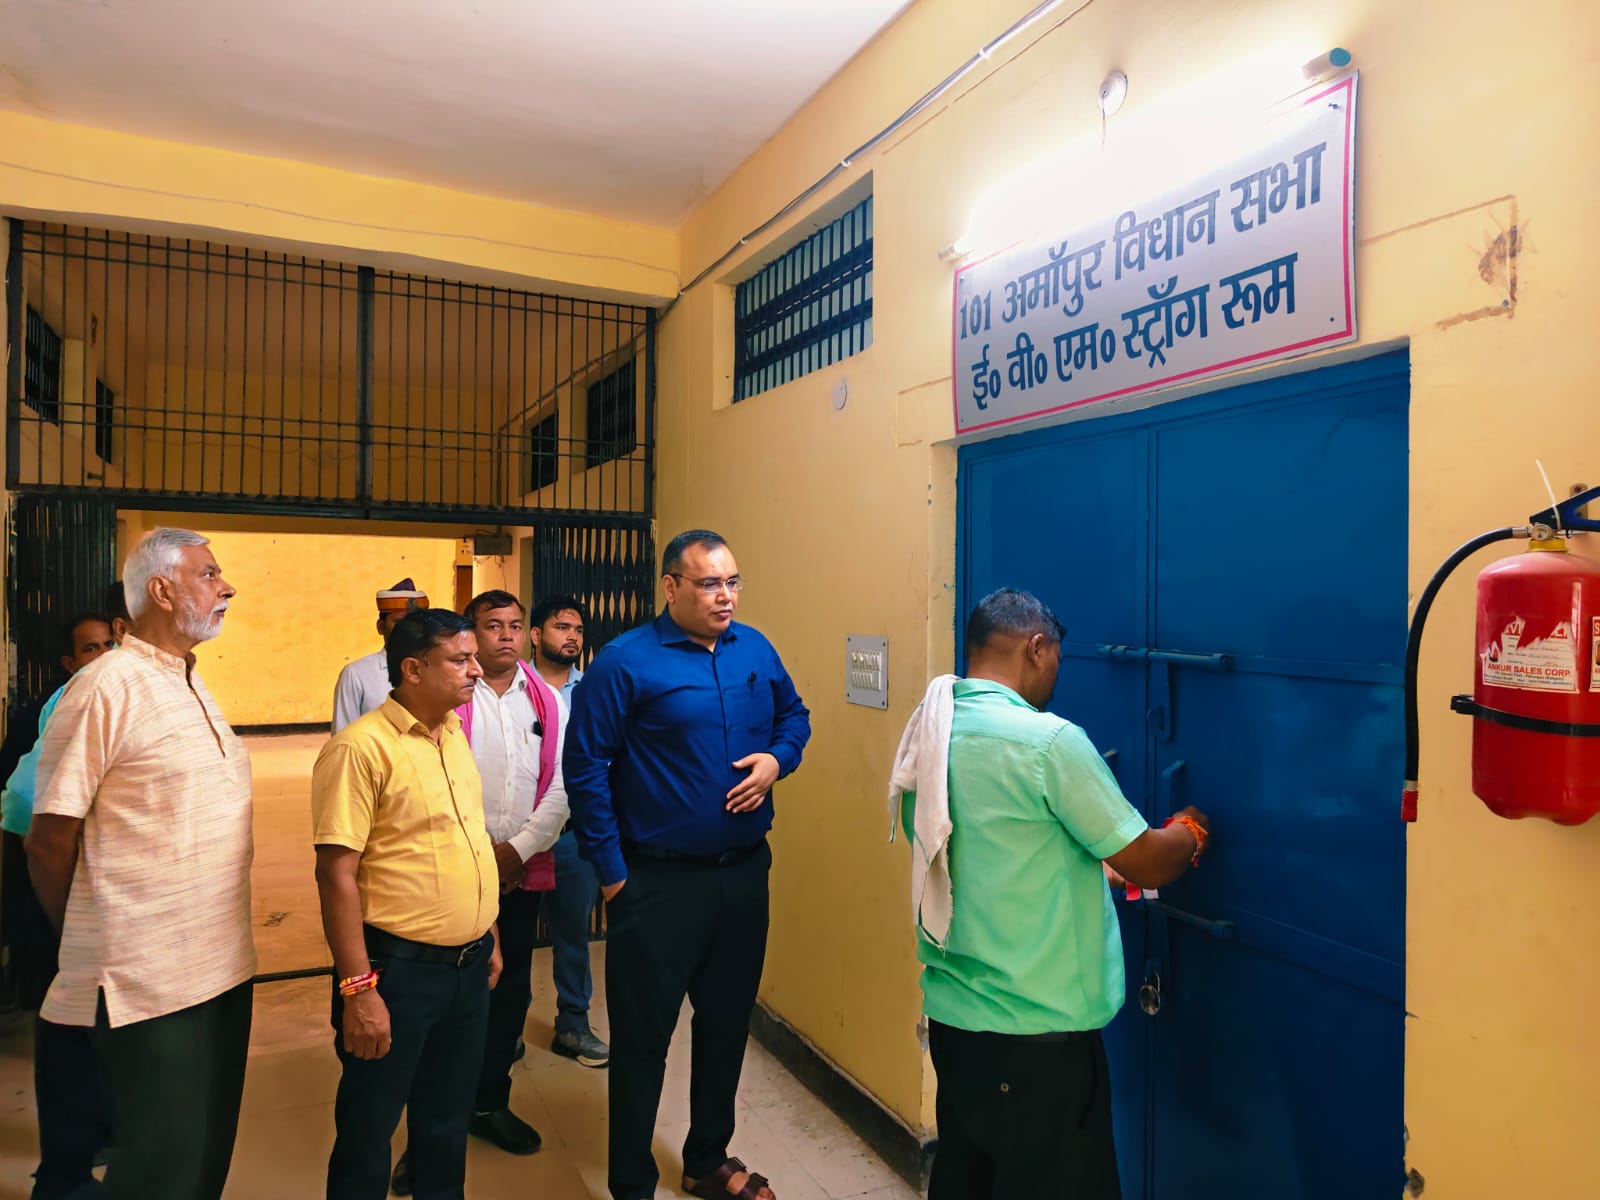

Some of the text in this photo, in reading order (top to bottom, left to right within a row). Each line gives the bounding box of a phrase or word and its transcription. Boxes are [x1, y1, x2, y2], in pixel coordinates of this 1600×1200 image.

[960, 290, 991, 340] 101
[1113, 189, 1220, 281] विधान
[1230, 141, 1327, 233] सभा
[1219, 252, 1299, 330] रूम
[1488, 663, 1511, 673] ANKUR
[1514, 665, 1542, 675] SALES
[1545, 668, 1571, 677] CORP.
